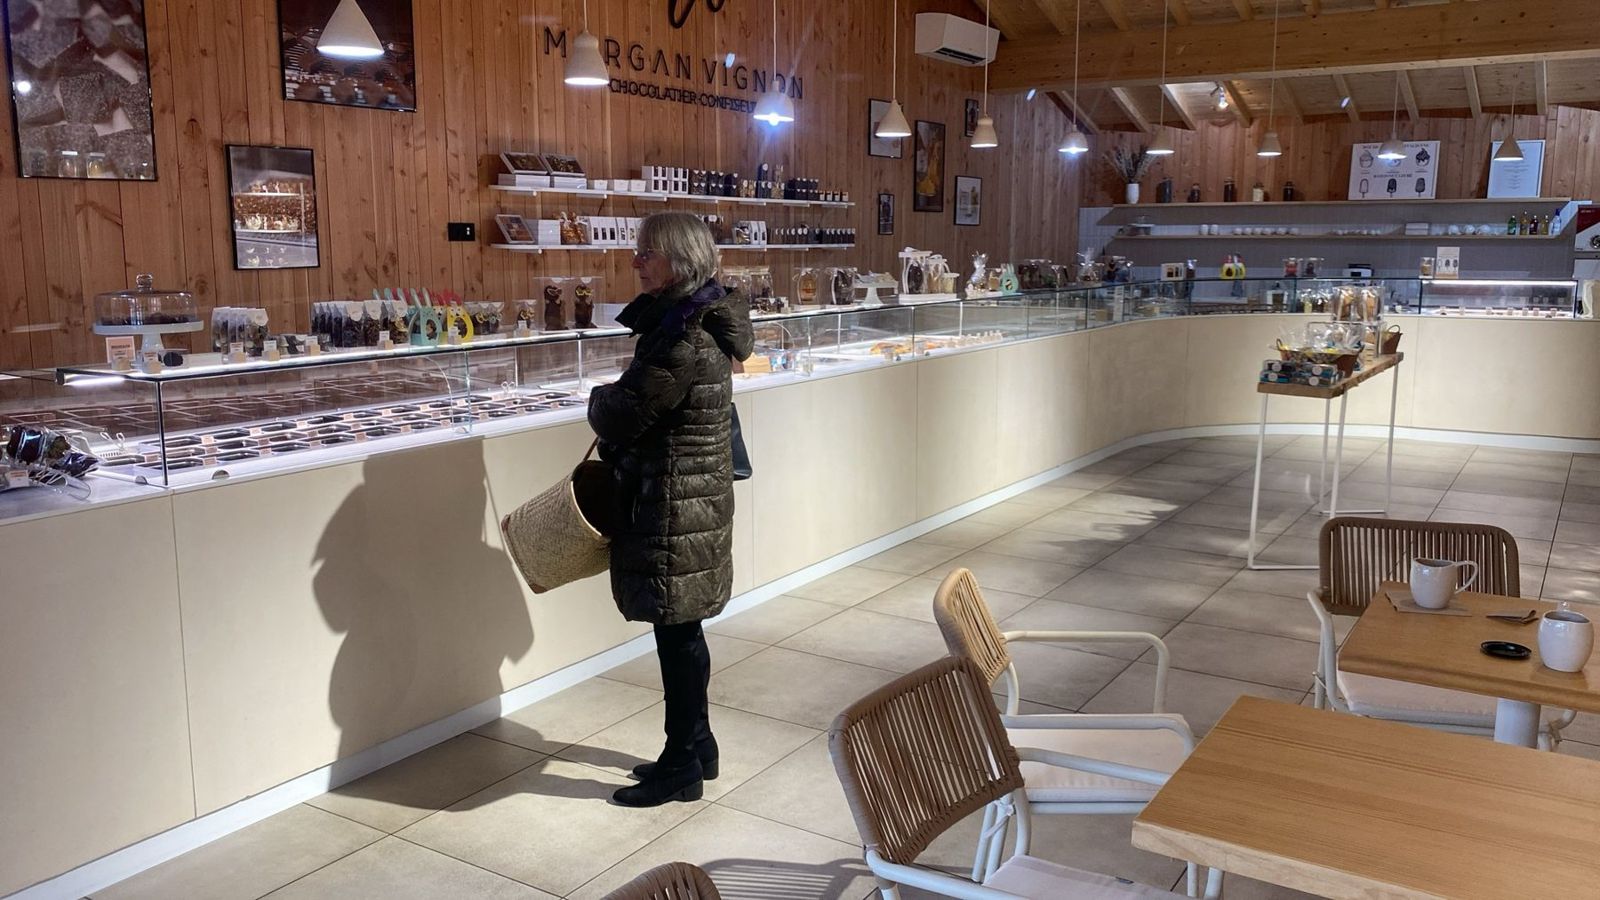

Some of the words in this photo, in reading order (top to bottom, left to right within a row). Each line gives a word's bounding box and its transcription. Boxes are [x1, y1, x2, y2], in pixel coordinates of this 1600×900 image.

[544, 26, 692, 80] MRGAN
[609, 78, 697, 105] CHOCOLATIER
[700, 92, 758, 114] CONFISEU
